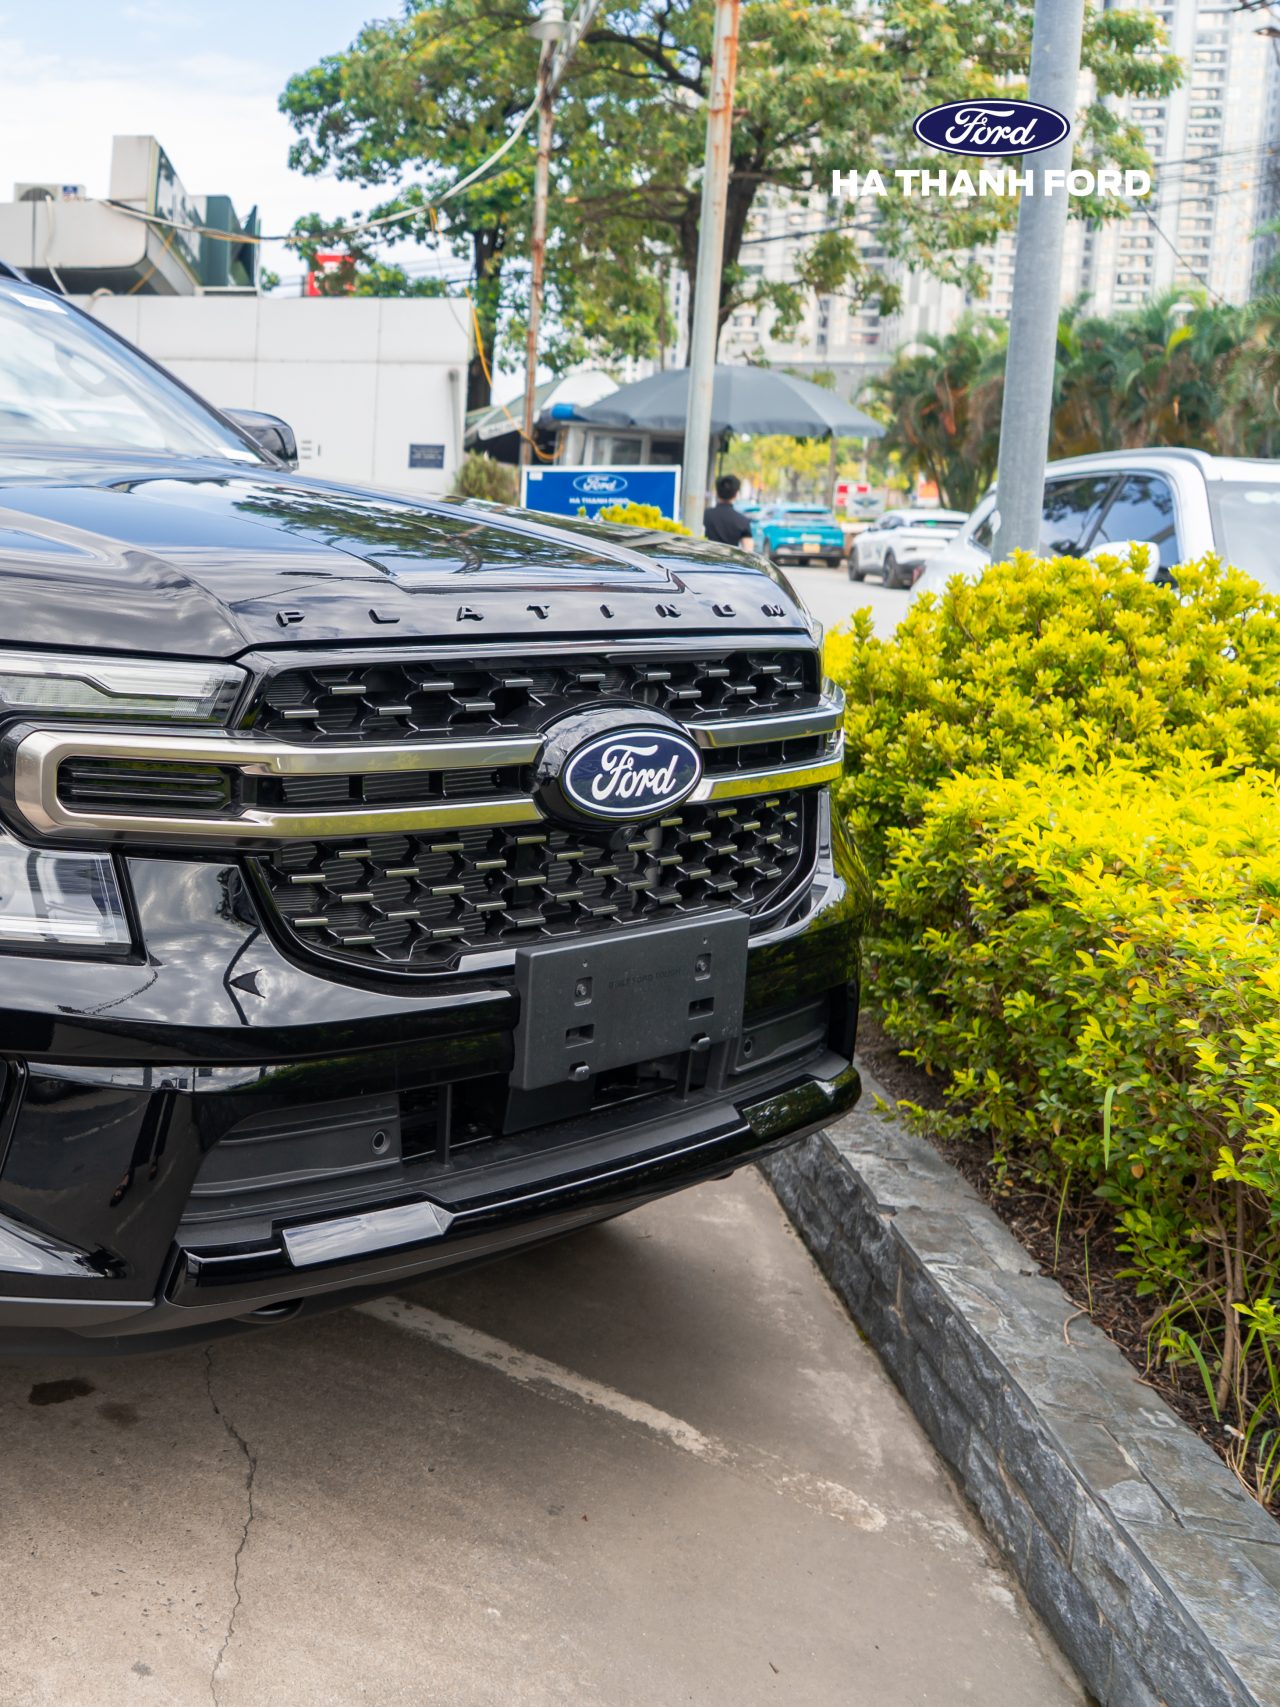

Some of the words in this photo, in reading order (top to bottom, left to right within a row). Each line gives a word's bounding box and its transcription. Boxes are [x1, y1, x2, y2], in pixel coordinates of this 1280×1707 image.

[583, 474, 617, 492] Ford
[276, 603, 788, 628] PLATINUM
[591, 744, 679, 801] Ford
